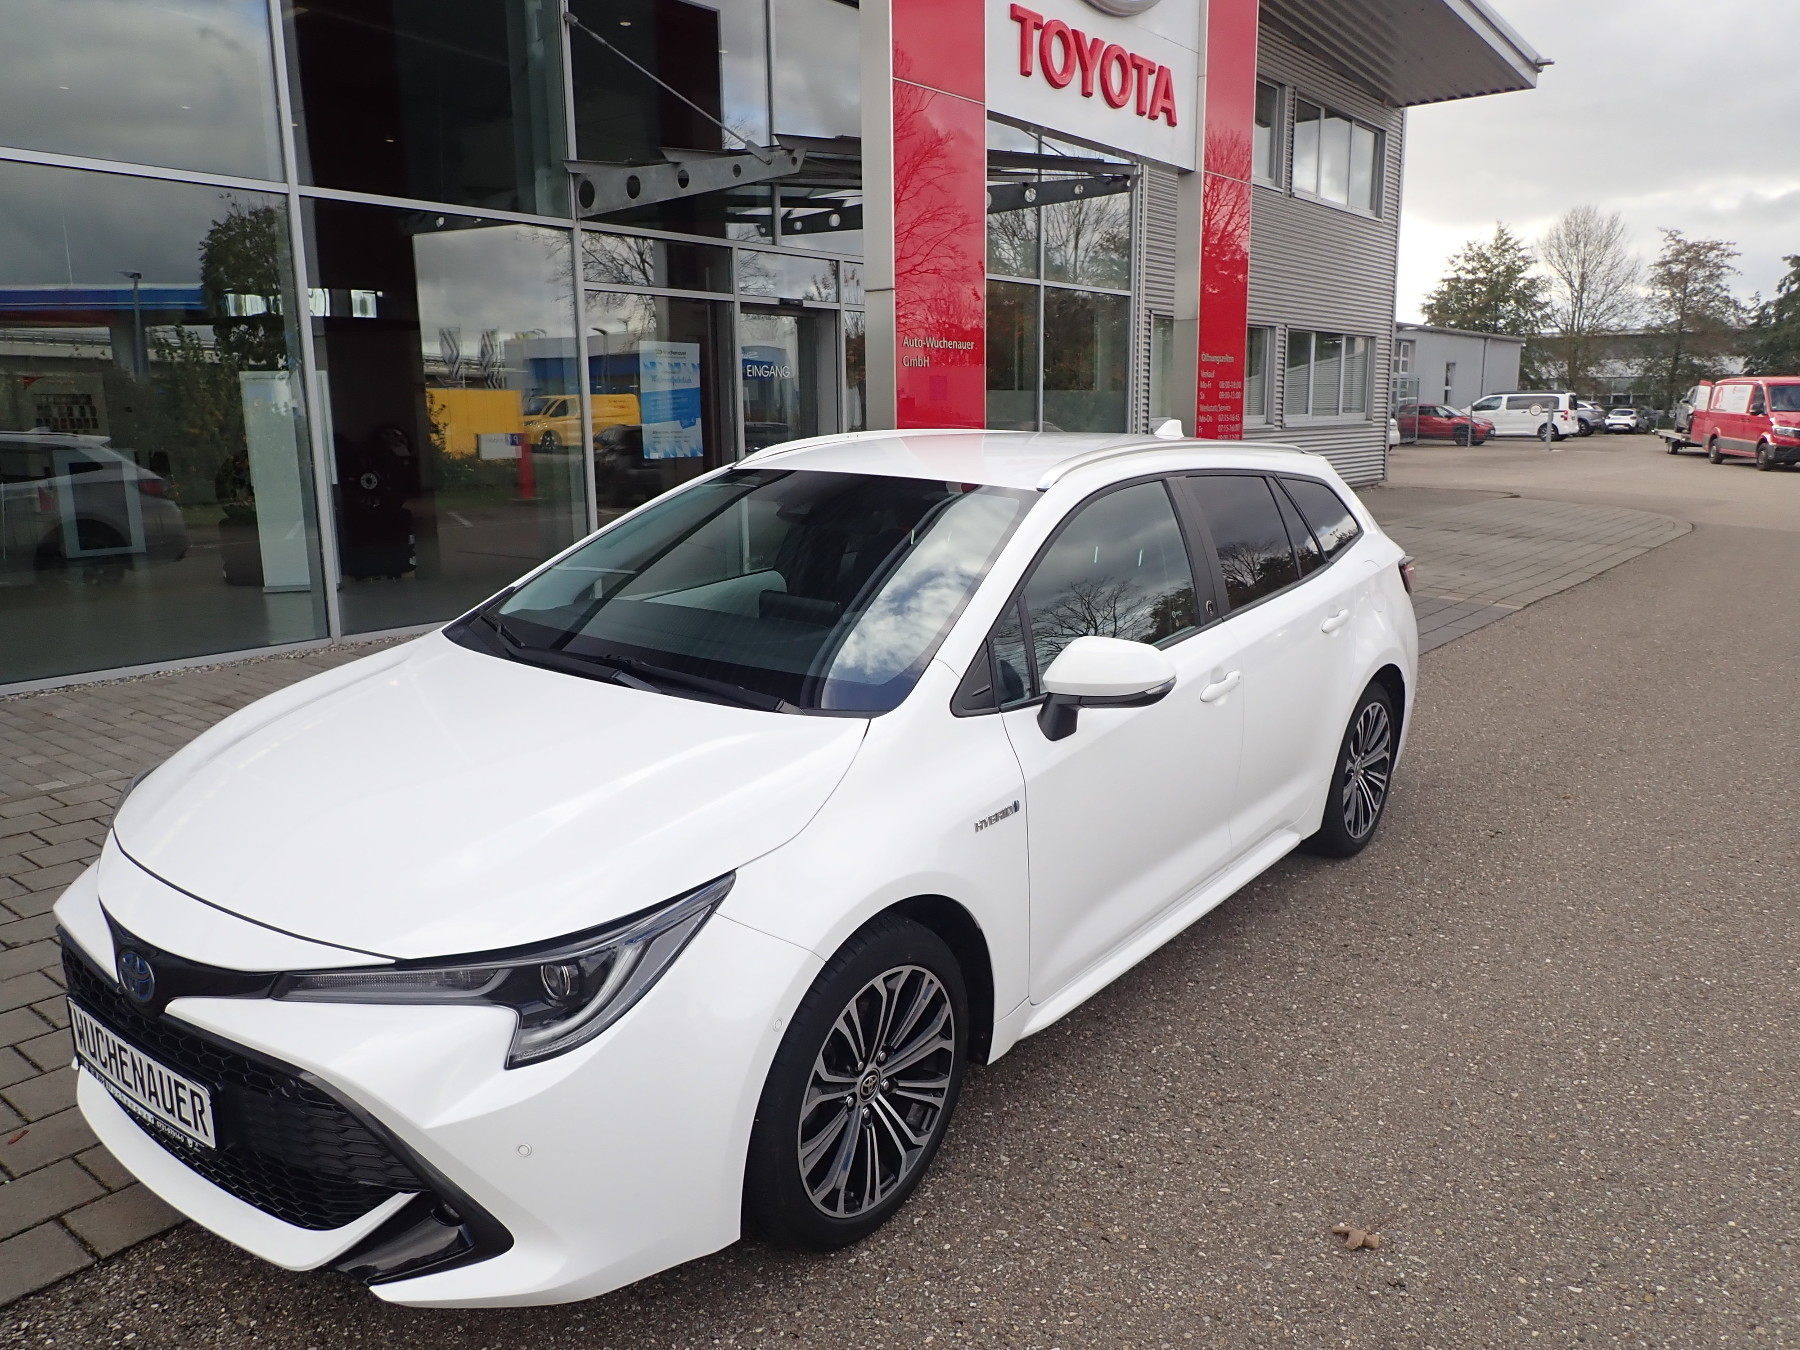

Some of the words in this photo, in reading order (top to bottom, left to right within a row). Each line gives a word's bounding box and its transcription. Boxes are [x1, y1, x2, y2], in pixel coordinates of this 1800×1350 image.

[1010, 4, 1177, 127] TOYOTA
[903, 335, 975, 350] Auto-Wuchenauer
[746, 364, 790, 378] EINGANG
[903, 355, 930, 367] GmbH
[974, 805, 1013, 832] HYBRID
[73, 1008, 209, 1137] WUCHENAUER
